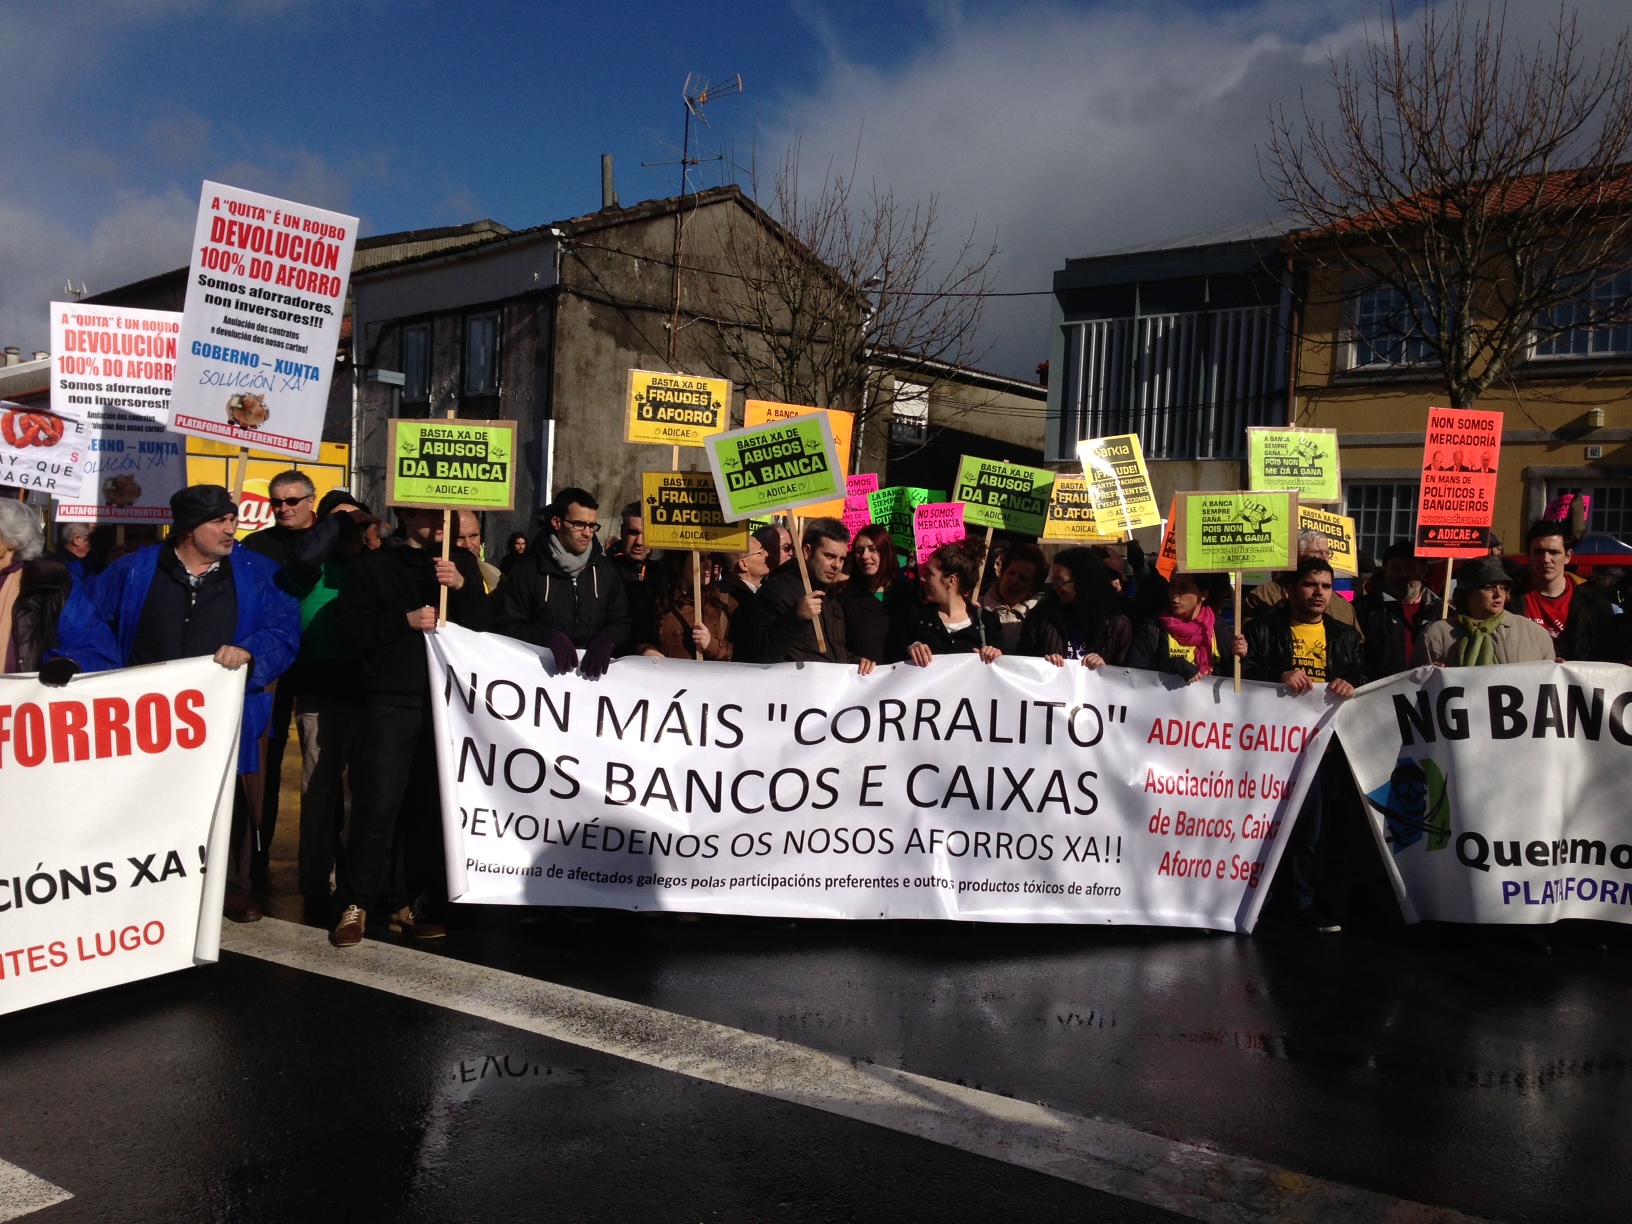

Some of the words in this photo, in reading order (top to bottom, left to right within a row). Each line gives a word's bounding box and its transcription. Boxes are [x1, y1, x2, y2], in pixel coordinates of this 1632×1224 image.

[211, 197, 220, 211] A
[273, 210, 280, 225] É
[284, 214, 300, 229] UN
[303, 218, 345, 240] ROUBO
[210, 216, 340, 270] DEVOLUCIÓN
[200, 246, 244, 276] 100%
[249, 257, 272, 282] DO
[275, 263, 342, 298] AFORRO
[198, 274, 246, 295] Somos
[249, 284, 334, 316] aforradores,
[204, 294, 231, 308] non
[234, 298, 323, 328] inversores!!!
[142, 320, 179, 333] ROUBO
[216, 327, 251, 342] devolución
[223, 316, 255, 330] Anulación
[256, 323, 268, 333] dos
[269, 327, 300, 340] contratos
[64, 329, 177, 359] DEVOLUCIÓN
[58, 356, 99, 376] 100%
[103, 359, 123, 377] DO
[191, 341, 260, 368] GOBERNO
[274, 358, 320, 381] XUNTA
[60, 380, 103, 392] Somos
[652, 378, 679, 388] BASTA
[682, 381, 693, 389] XA
[697, 382, 708, 390] DE
[68, 395, 92, 404] non
[649, 389, 708, 406] FRAUDES
[642, 403, 652, 418] Ó
[657, 408, 712, 424] AFORRO
[1431, 416, 1454, 428] NON
[1458, 418, 1494, 431] SOMOS
[177, 416, 232, 436] PLATAFORMA
[233, 427, 288, 448] PREFERENTES
[289, 440, 311, 453] LUGO
[420, 429, 454, 438] BASTA
[458, 430, 471, 439] XA
[475, 432, 488, 440] DE
[662, 428, 690, 437] ADICAE
[737, 436, 767, 450] BASTA
[770, 432, 784, 442] XA
[786, 428, 799, 438] DE
[1429, 433, 1496, 447] MERCADORÍA
[138, 441, 178, 456] XUNTA
[422, 442, 486, 458] ABUSOS
[744, 440, 802, 466] ABUSOS
[36, 461, 73, 476] QUE
[402, 460, 430, 476] DA
[436, 462, 503, 480] BANCA
[980, 463, 1008, 476] BASTA
[1265, 458, 1281, 466] POIS
[0, 471, 56, 489] AGAR
[730, 471, 750, 489] DA
[761, 456, 824, 482] BANCA
[1300, 468, 1322, 476] GANA
[1425, 475, 1436, 483] EN
[1438, 476, 1460, 484] MANS
[1463, 476, 1472, 484] DE
[435, 485, 469, 494] ADICAE
[664, 478, 693, 486] BASTA
[979, 474, 1030, 492] ABUSOS
[662, 491, 720, 504] FRAUDE
[766, 484, 798, 498] ADICAE
[1424, 484, 1475, 499] POLÍTICOS
[1479, 488, 1485, 499] E
[961, 486, 983, 502] DA
[988, 490, 1041, 514] BANCA
[1423, 500, 1488, 512] BANQUEIROS
[60, 506, 110, 516] PLATAFORMA
[112, 508, 162, 518] PREFERENTES
[672, 510, 723, 524] AFORR
[918, 508, 928, 519] NO
[930, 508, 955, 517] SOMOS
[984, 510, 1011, 522] ADICAE
[1303, 510, 1322, 519] BASTA
[918, 519, 960, 530] MERCANCÍA
[1203, 524, 1221, 533] POIS
[1224, 524, 1242, 532] NON
[1302, 518, 1342, 536] FRAUDES
[680, 531, 710, 539] ADICAE
[1220, 534, 1233, 543] DÁ
[1244, 534, 1270, 542] GANA
[1438, 528, 1471, 539] ADICAE
[1227, 554, 1250, 562] ADICAE
[444, 664, 571, 733] NON
[596, 689, 744, 749] MÁIS
[768, 698, 1128, 748] "CORRALITO"
[1392, 686, 1470, 746] NG
[1147, 718, 1234, 750] ADICAE
[458, 736, 581, 800] NOS
[604, 762, 840, 814] BANCOS
[859, 765, 887, 807] E
[906, 764, 1099, 815] CAIXAS
[1144, 768, 1234, 799] Asociación
[1238, 772, 1256, 799] de
[1148, 808, 1170, 835] de
[1174, 811, 1236, 843] Bancos,
[730, 831, 773, 858] OS
[784, 828, 894, 855] NOSOS
[904, 828, 1054, 861] AFORROS
[1062, 836, 1122, 864] XA!!
[1455, 831, 1632, 872] Queremo
[127, 850, 187, 888] XA
[1158, 851, 1212, 879] Aforro
[1216, 860, 1226, 879] e
[1230, 854, 1265, 889] Seg
[466, 858, 542, 878] Plataforma
[546, 864, 564, 879] de
[568, 867, 634, 885] afectados
[636, 873, 688, 888] galegos
[690, 874, 726, 889] polas
[730, 873, 821, 890] participacións
[825, 875, 899, 891] preferentes
[903, 878, 910, 889] e
[914, 876, 954, 890] outros
[958, 878, 1020, 895] productos
[1023, 878, 1064, 895] tóxicos
[1067, 880, 1083, 895] de
[1086, 881, 1122, 897] aforro
[0, 940, 68, 980] TES
[77, 920, 165, 962] LUGO
